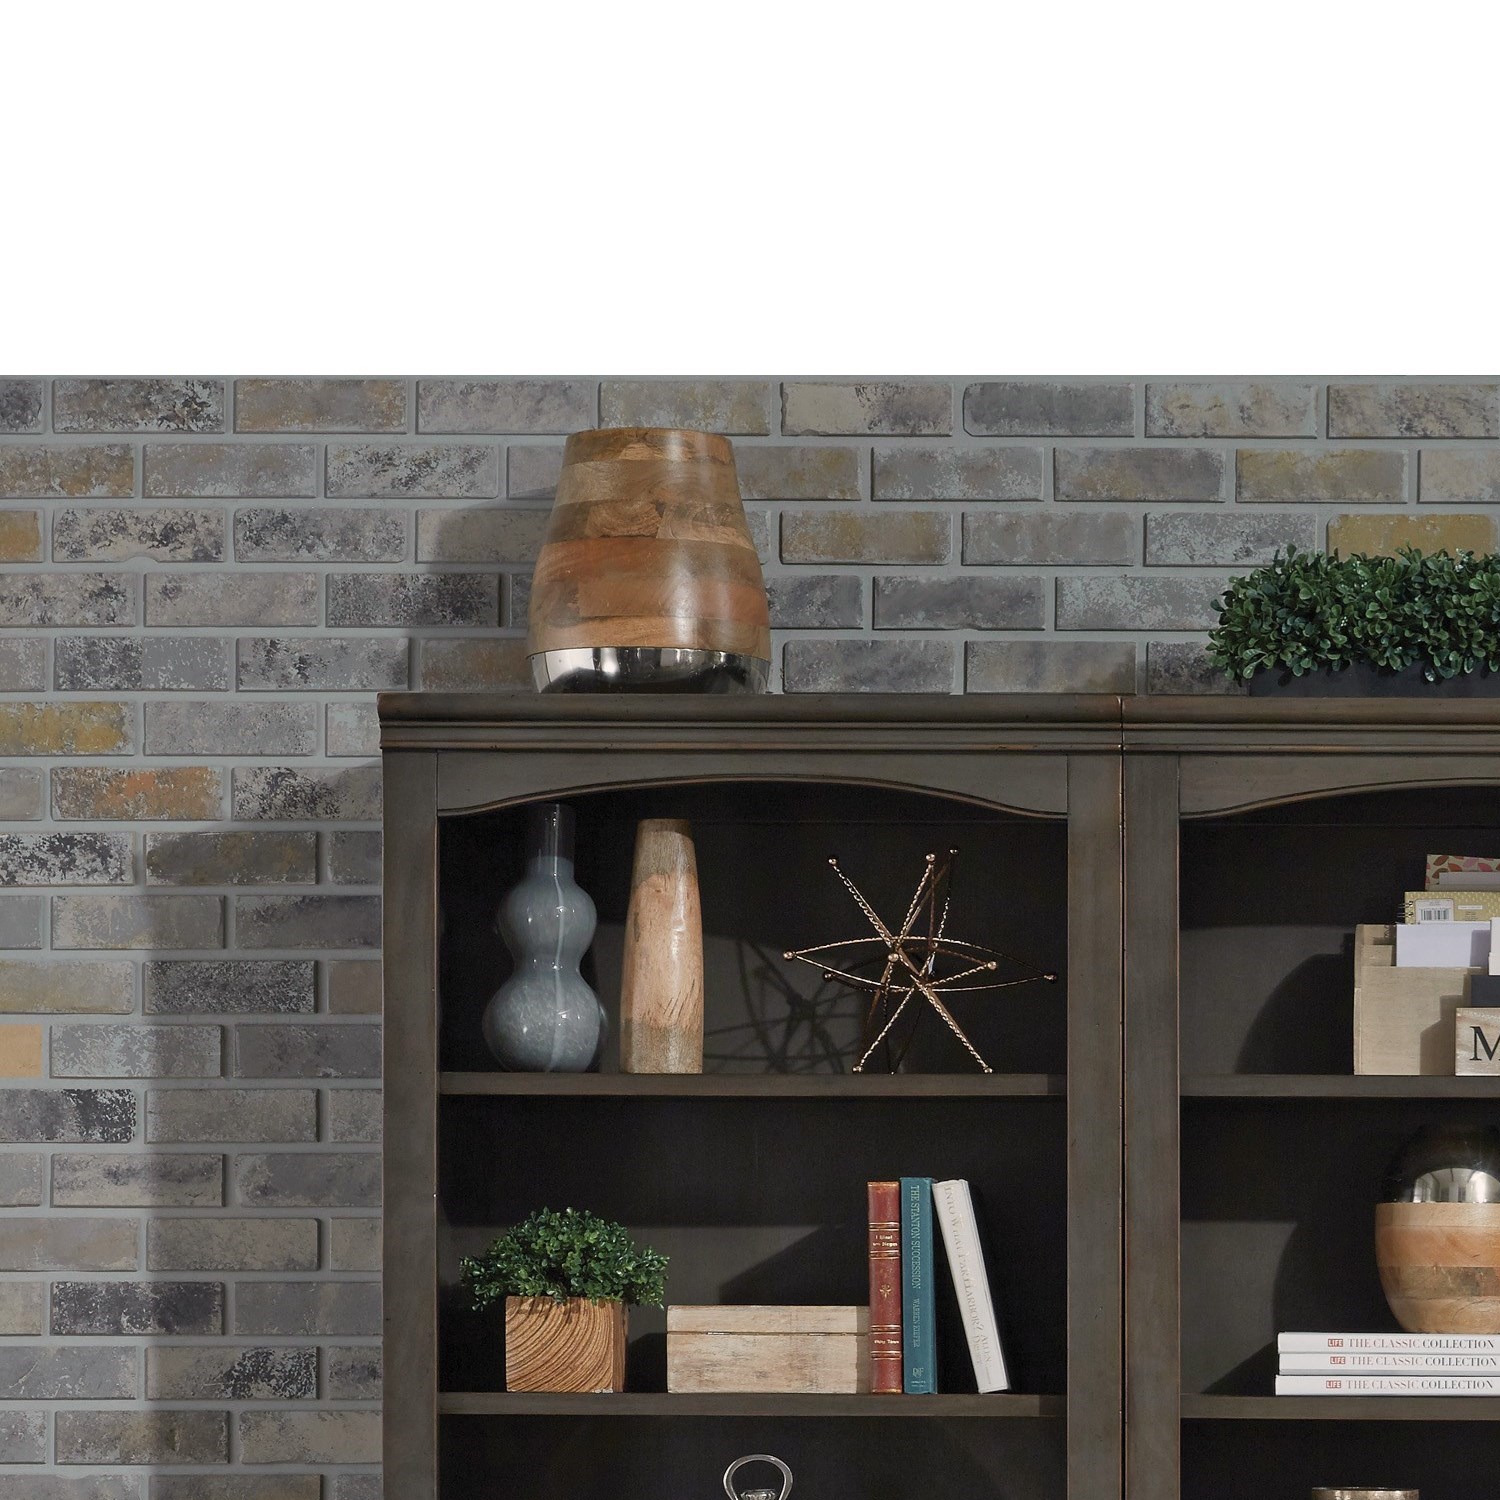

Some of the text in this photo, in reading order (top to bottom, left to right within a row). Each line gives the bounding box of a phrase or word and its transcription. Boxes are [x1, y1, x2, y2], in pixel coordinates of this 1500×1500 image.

[944, 1186, 954, 1214] INTO
[911, 1184, 921, 1289] THE STANTON SUCCESSION
[1328, 1338, 1495, 1349] LIFE THE CLASSIC COLLECTION
[1330, 1356, 1497, 1366] LIFE THE CLASSIC COLLECTION
[1326, 1380, 1493, 1389] LIFE THE CLASSIC COLLECTION
